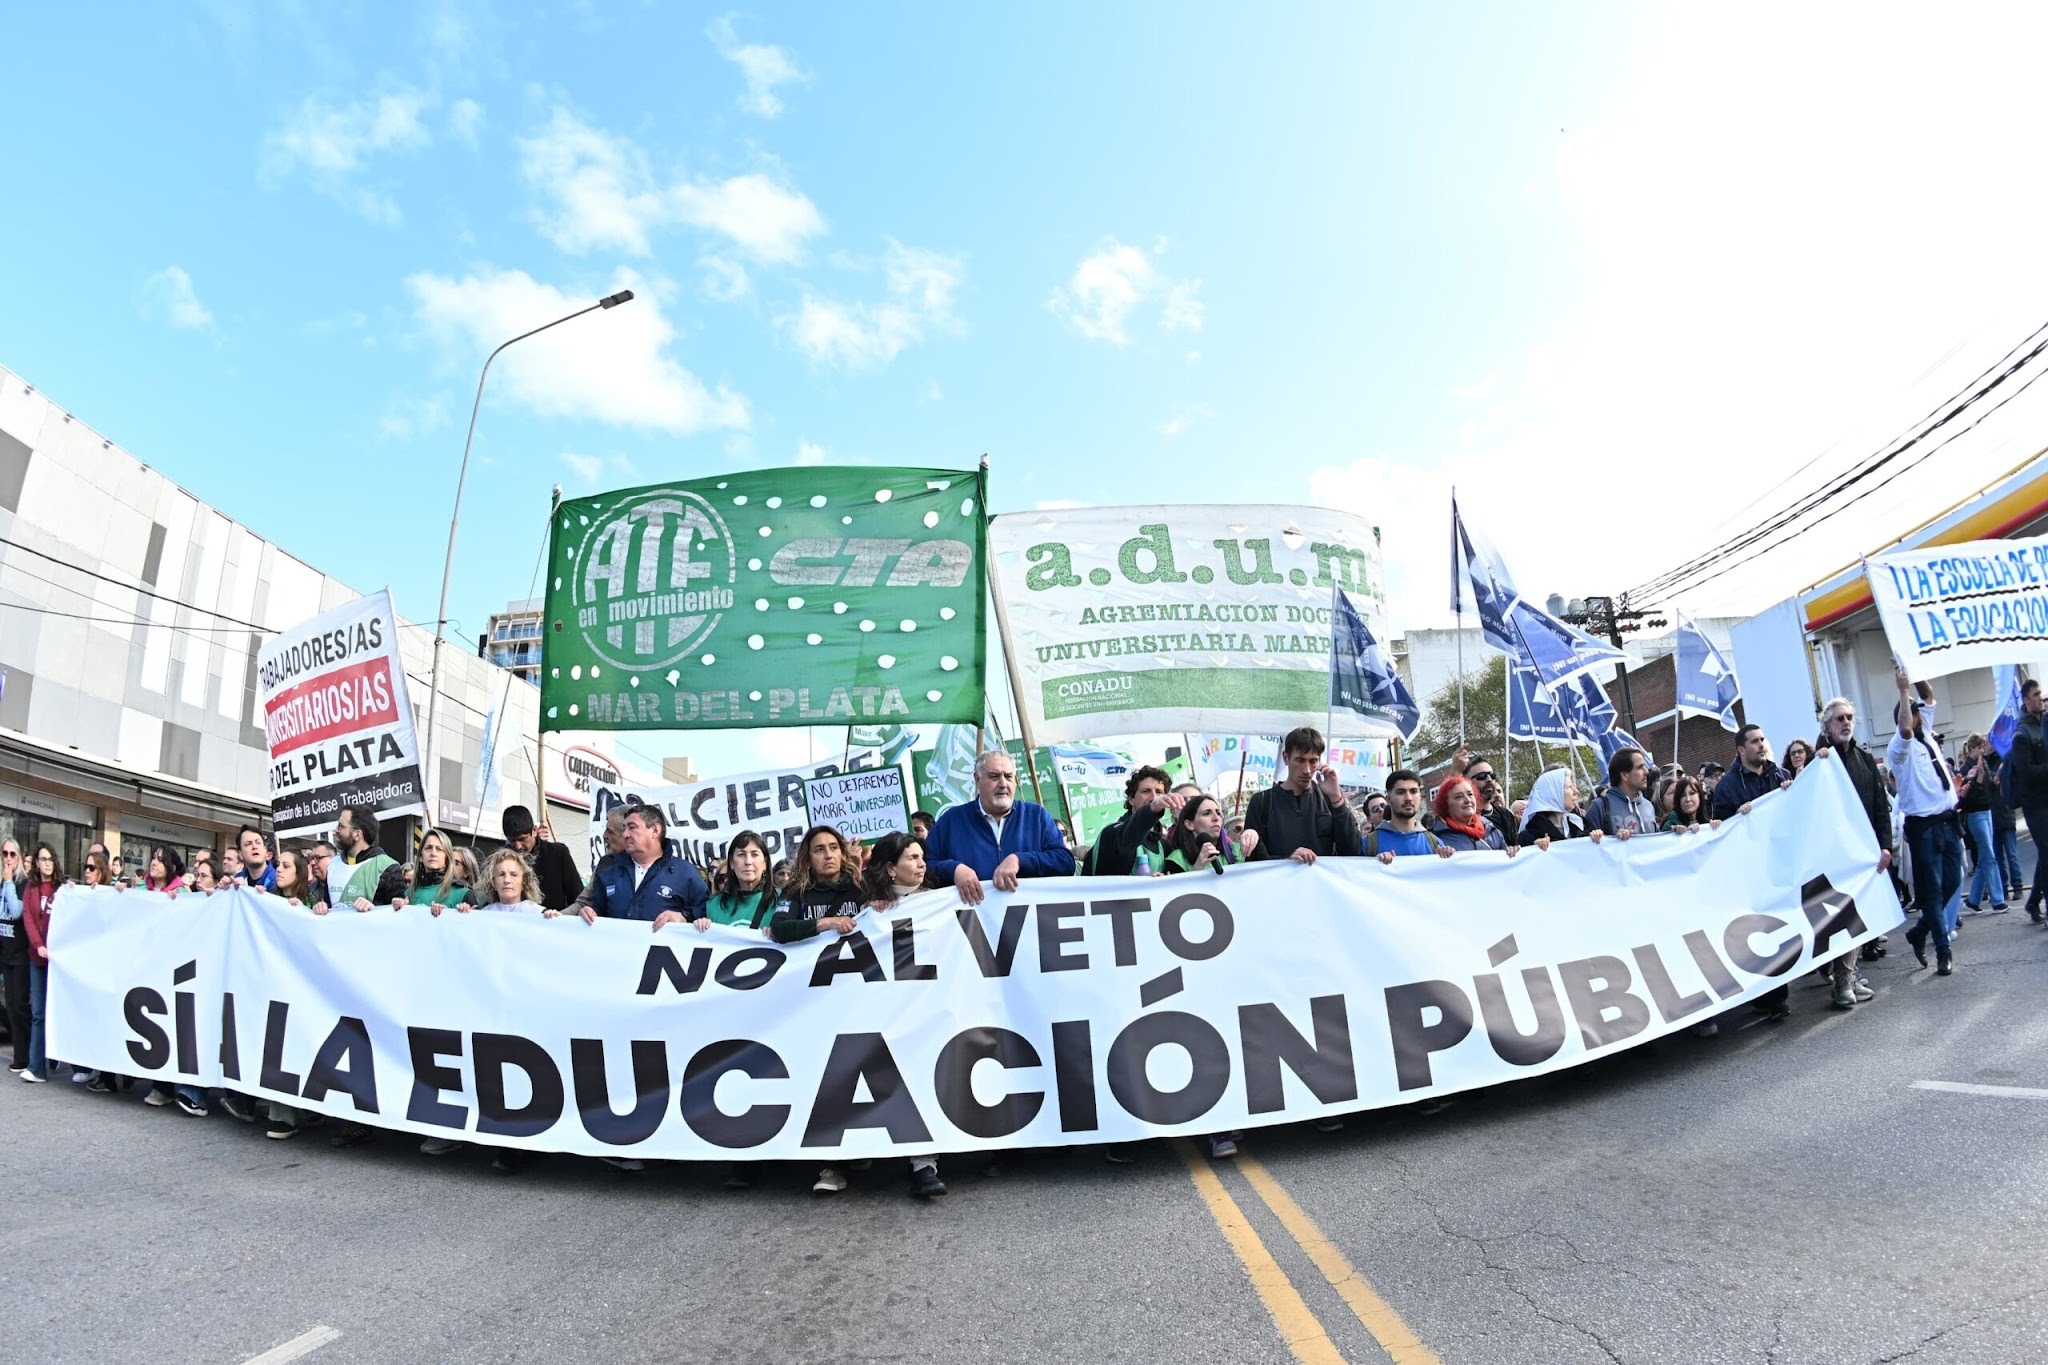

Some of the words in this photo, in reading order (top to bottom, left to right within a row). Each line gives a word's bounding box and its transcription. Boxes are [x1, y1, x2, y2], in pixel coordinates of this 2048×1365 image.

[585, 498, 719, 654] ATE
[769, 538, 972, 587] CTA
[1902, 565, 1933, 600] LA
[1927, 555, 2015, 596] ESCUELA
[2008, 549, 2038, 583] DE
[578, 606, 598, 629] en
[609, 585, 734, 623] movimiento
[1079, 604, 1278, 626] AGREMIACION
[1907, 611, 1949, 648] LA
[1036, 633, 1255, 663] UNIVERSITARIA
[1058, 676, 1132, 697] CONADU
[1707, 699, 1719, 708] pas
[587, 692, 662, 722] MAR
[674, 690, 754, 722] DEL
[769, 687, 909, 719] PLATA
[854, 726, 873, 738] Mar
[1541, 725, 1556, 733] paso
[275, 760, 299, 790] DEL
[304, 733, 404, 781] PLATA
[295, 804, 303, 818] de
[303, 802, 310, 817] la
[312, 797, 339, 815] Clase
[340, 781, 413, 806] Trabajadora
[811, 782, 833, 800] NO
[838, 772, 899, 794] DEJAREMOS
[27, 799, 56, 811] MARCHAL
[156, 826, 181, 838] MARCHAL
[635, 945, 787, 995] NO
[808, 918, 938, 988] AL
[956, 893, 1234, 979] VETO
[123, 959, 199, 1076] SÍ
[259, 1000, 380, 1115] LA
[406, 966, 1358, 1149] EDUCACIÓN
[1384, 873, 1868, 1092] PÚBLICA
